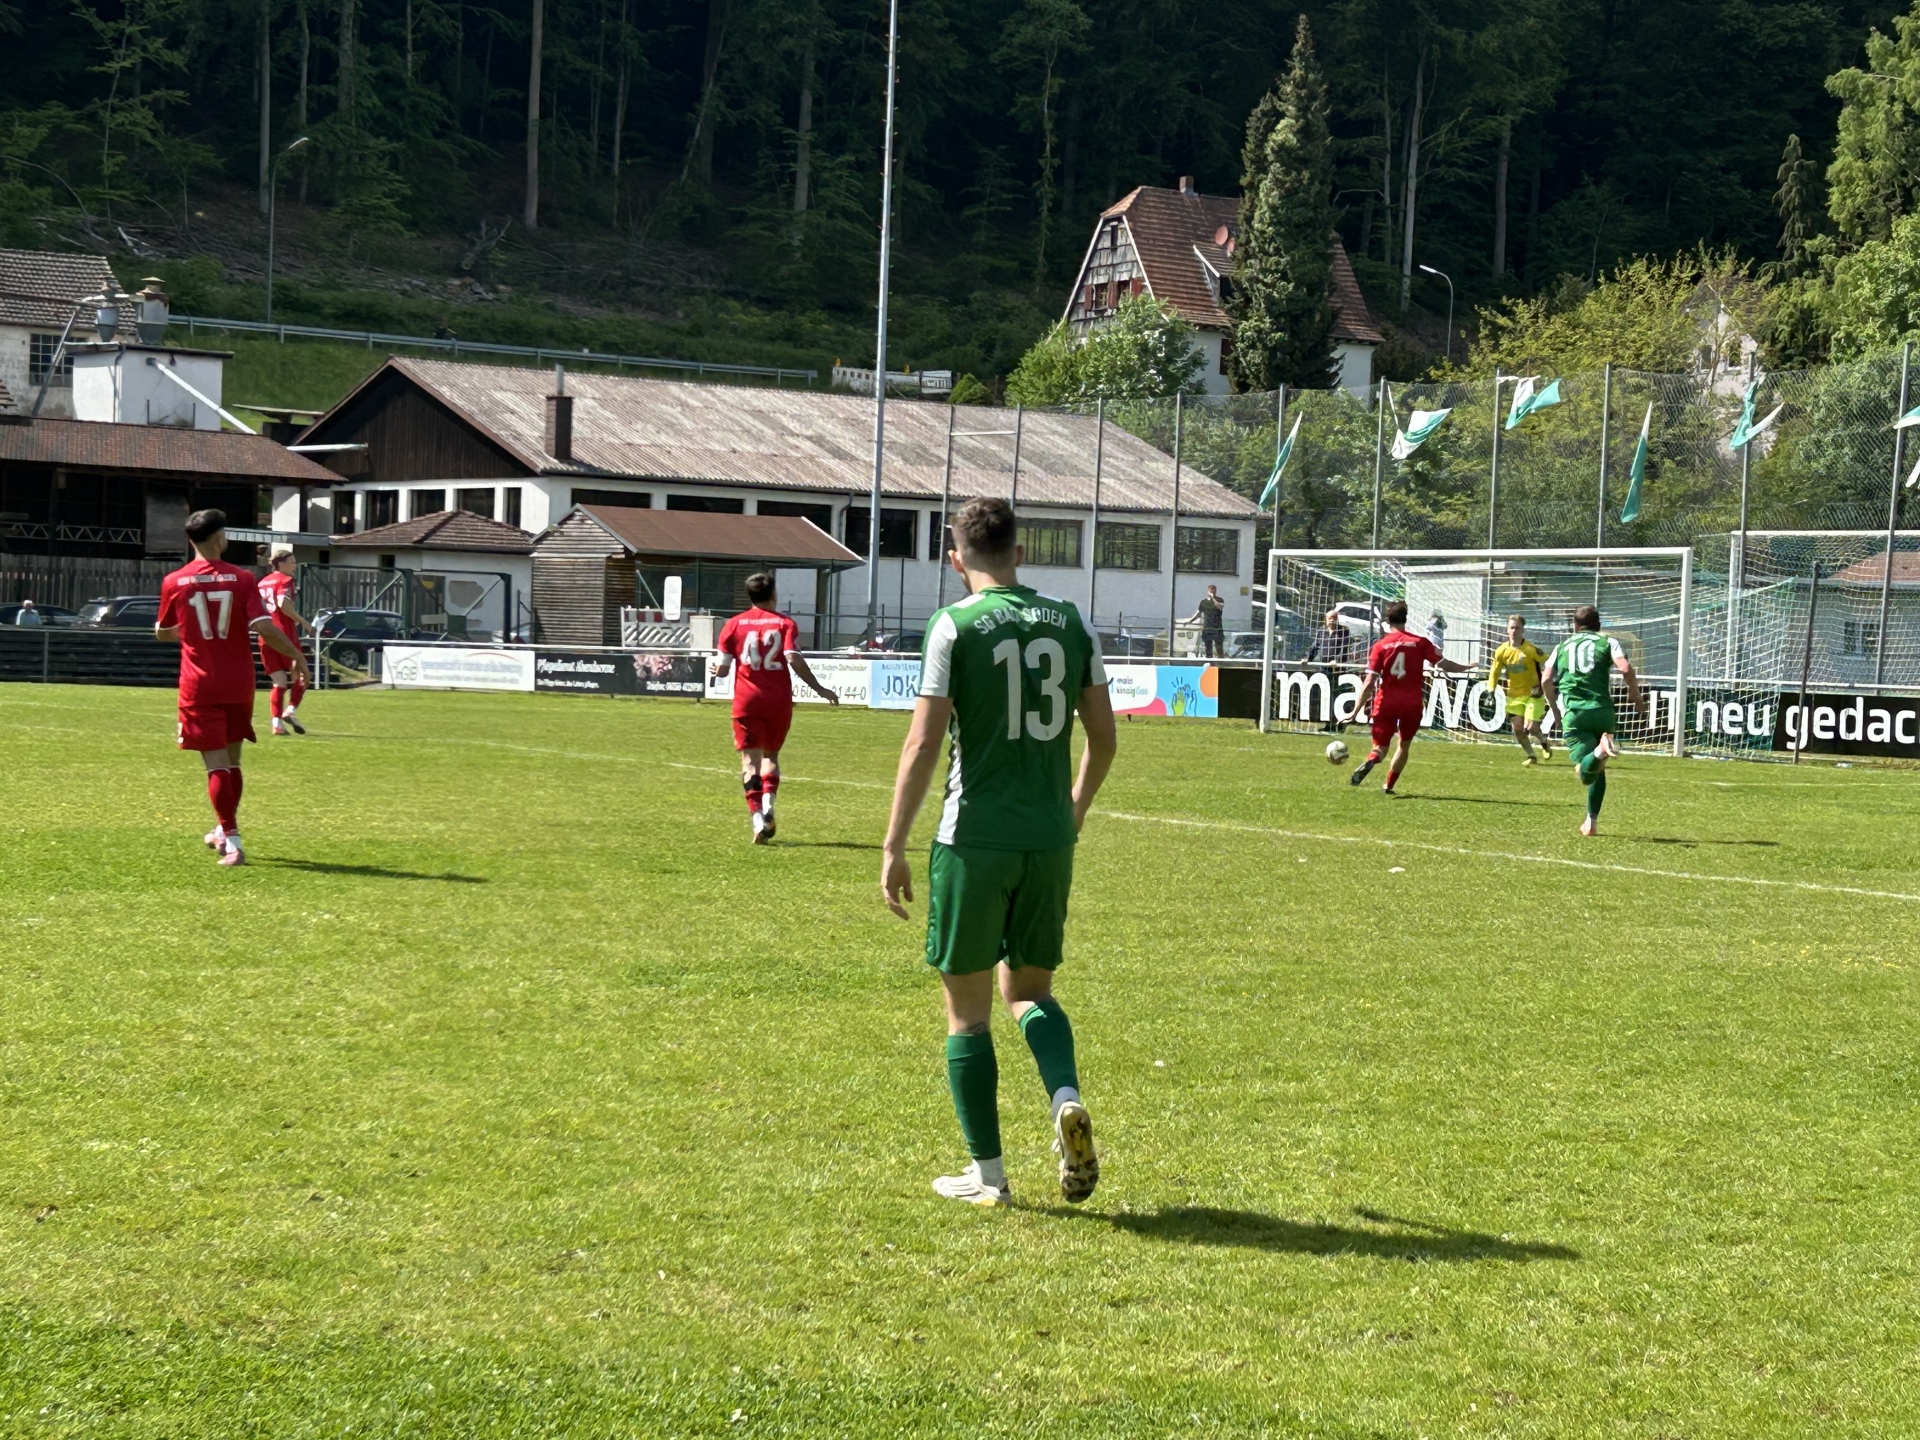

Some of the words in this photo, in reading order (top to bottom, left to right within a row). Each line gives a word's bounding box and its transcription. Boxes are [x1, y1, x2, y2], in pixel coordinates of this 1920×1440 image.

[188, 590, 234, 641] 17
[973, 614, 997, 635] SG
[992, 606, 1021, 625] BAD
[1021, 606, 1068, 630] SODEN
[740, 628, 784, 671] 42
[1390, 651, 1407, 680] 4
[1563, 638, 1596, 674] 10
[992, 637, 1066, 741] 13
[1695, 700, 1771, 736] neu
